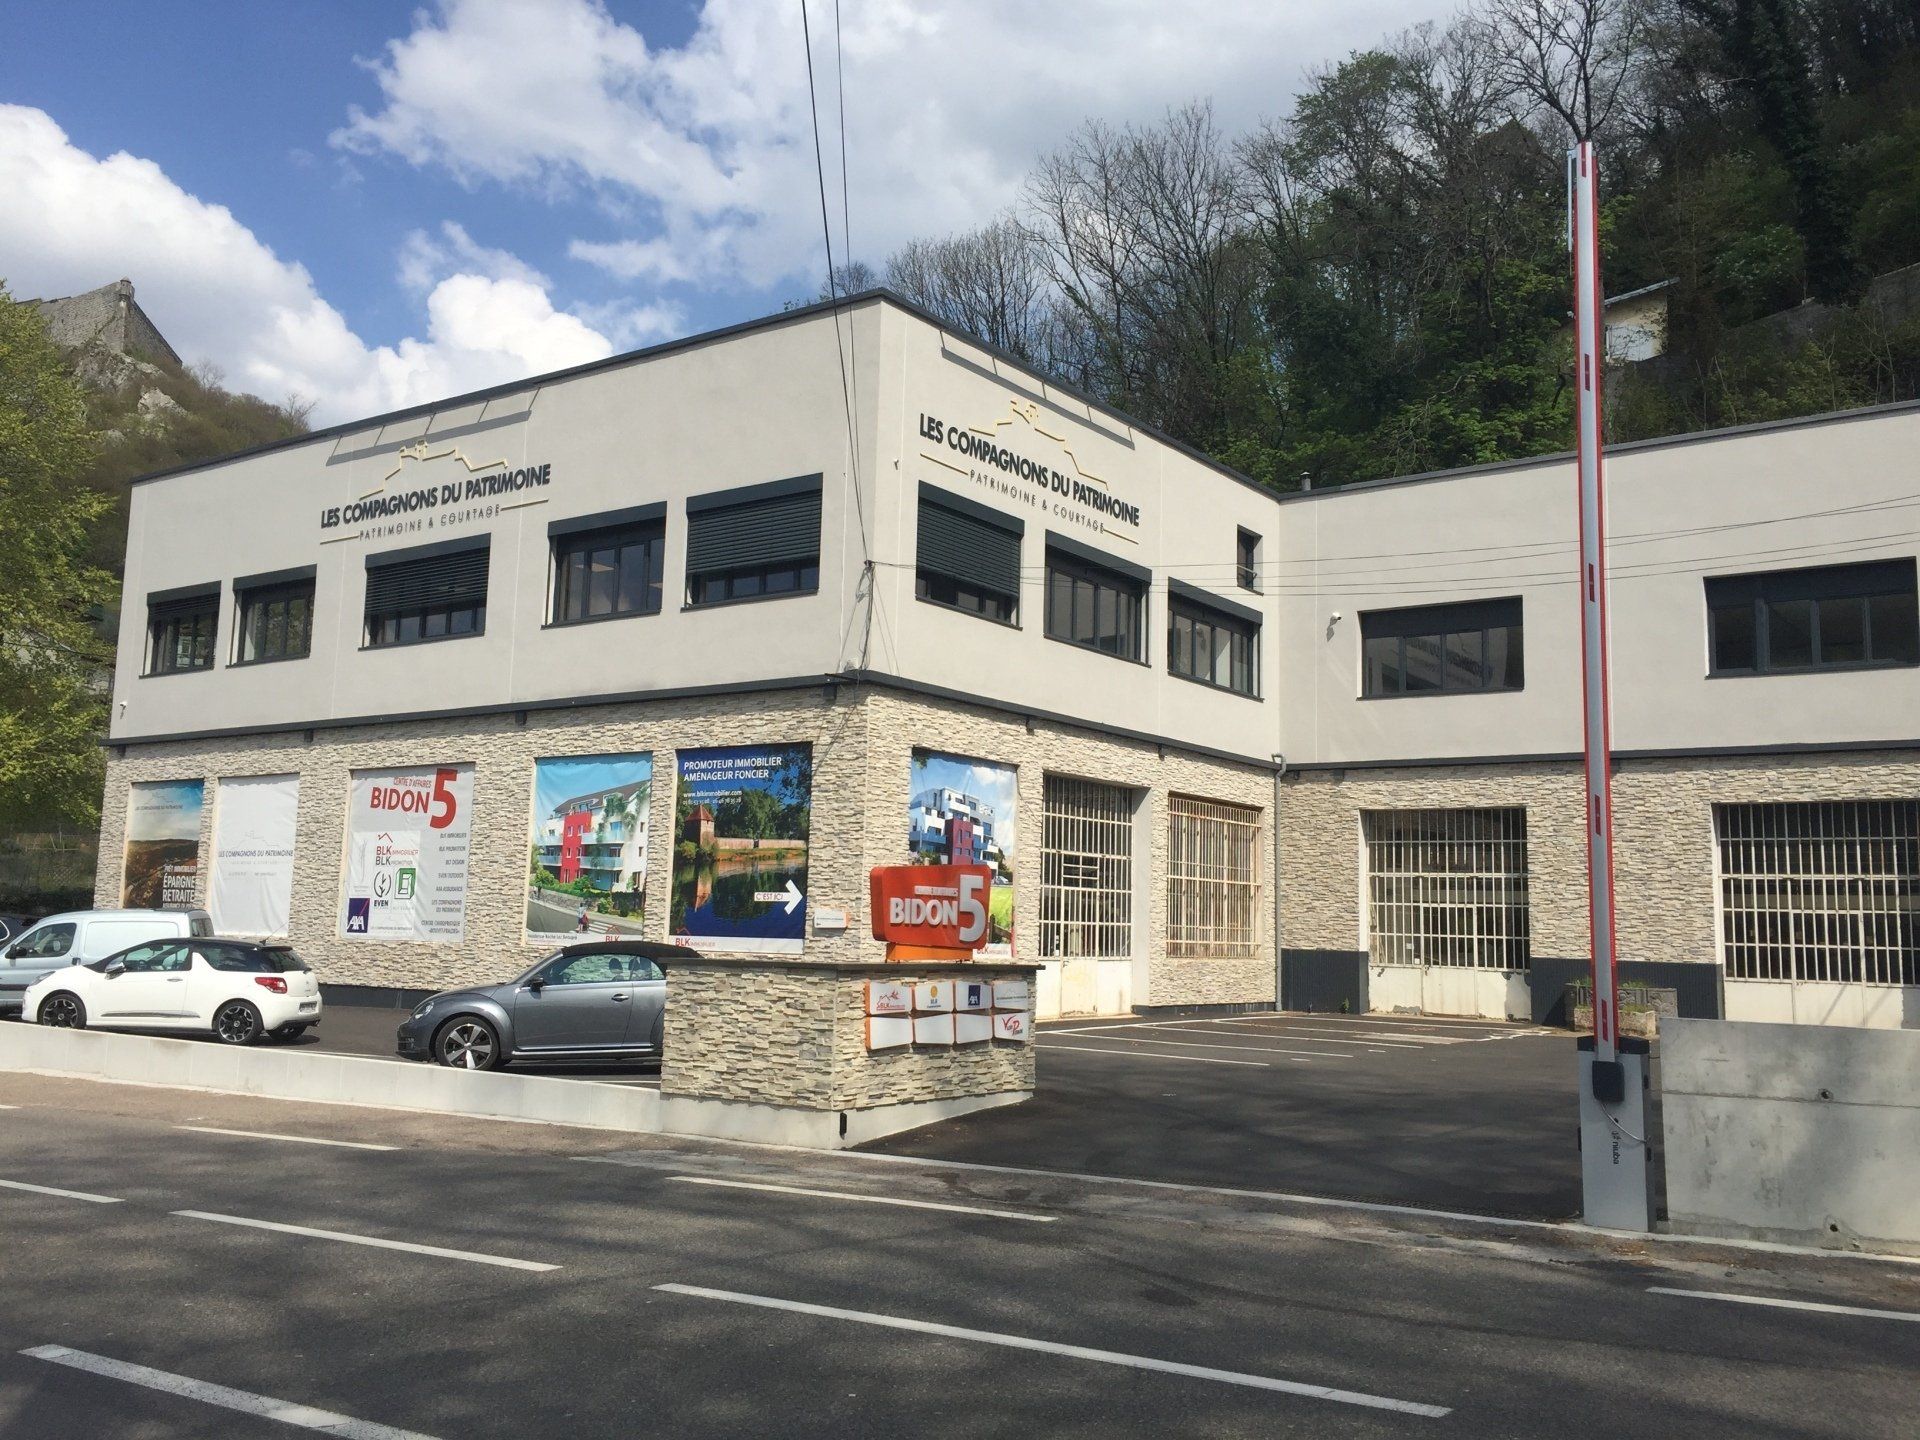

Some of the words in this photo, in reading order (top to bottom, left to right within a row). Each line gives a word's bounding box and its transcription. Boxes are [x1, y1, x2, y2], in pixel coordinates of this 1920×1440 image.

[920, 412, 944, 444] LES
[947, 426, 1048, 488] COMPAGNONS
[1052, 470, 1070, 497] DU
[1073, 480, 1140, 527] PATRIMOINE
[320, 507, 340, 528] LES
[342, 488, 438, 522] COMPAGNONS
[441, 482, 462, 504] DU
[466, 464, 552, 500] PATRIMOINE
[969, 469, 1036, 506] PATRIMOINE
[1042, 500, 1048, 510] &
[1053, 504, 1104, 534] COURTAGE
[360, 518, 422, 542] PATRIMOINE
[428, 519, 434, 528] &
[440, 504, 500, 526] COURTAGE
[684, 760, 733, 770] PROMOTEUR
[734, 756, 782, 768] IMMOBILIER
[684, 770, 734, 782] AMÉNAGEUR
[734, 770, 769, 778] FONCIER
[370, 787, 430, 813] BIDON
[430, 768, 458, 829] 5
[376, 846, 392, 856] BLK
[376, 856, 391, 865] BLK
[163, 873, 195, 888] ÉPARGNE
[163, 889, 195, 902] RETRAITE
[890, 897, 958, 926] BIDON
[959, 874, 986, 942] 5
[346, 915, 364, 930] AXA
[675, 938, 691, 947] BLK
